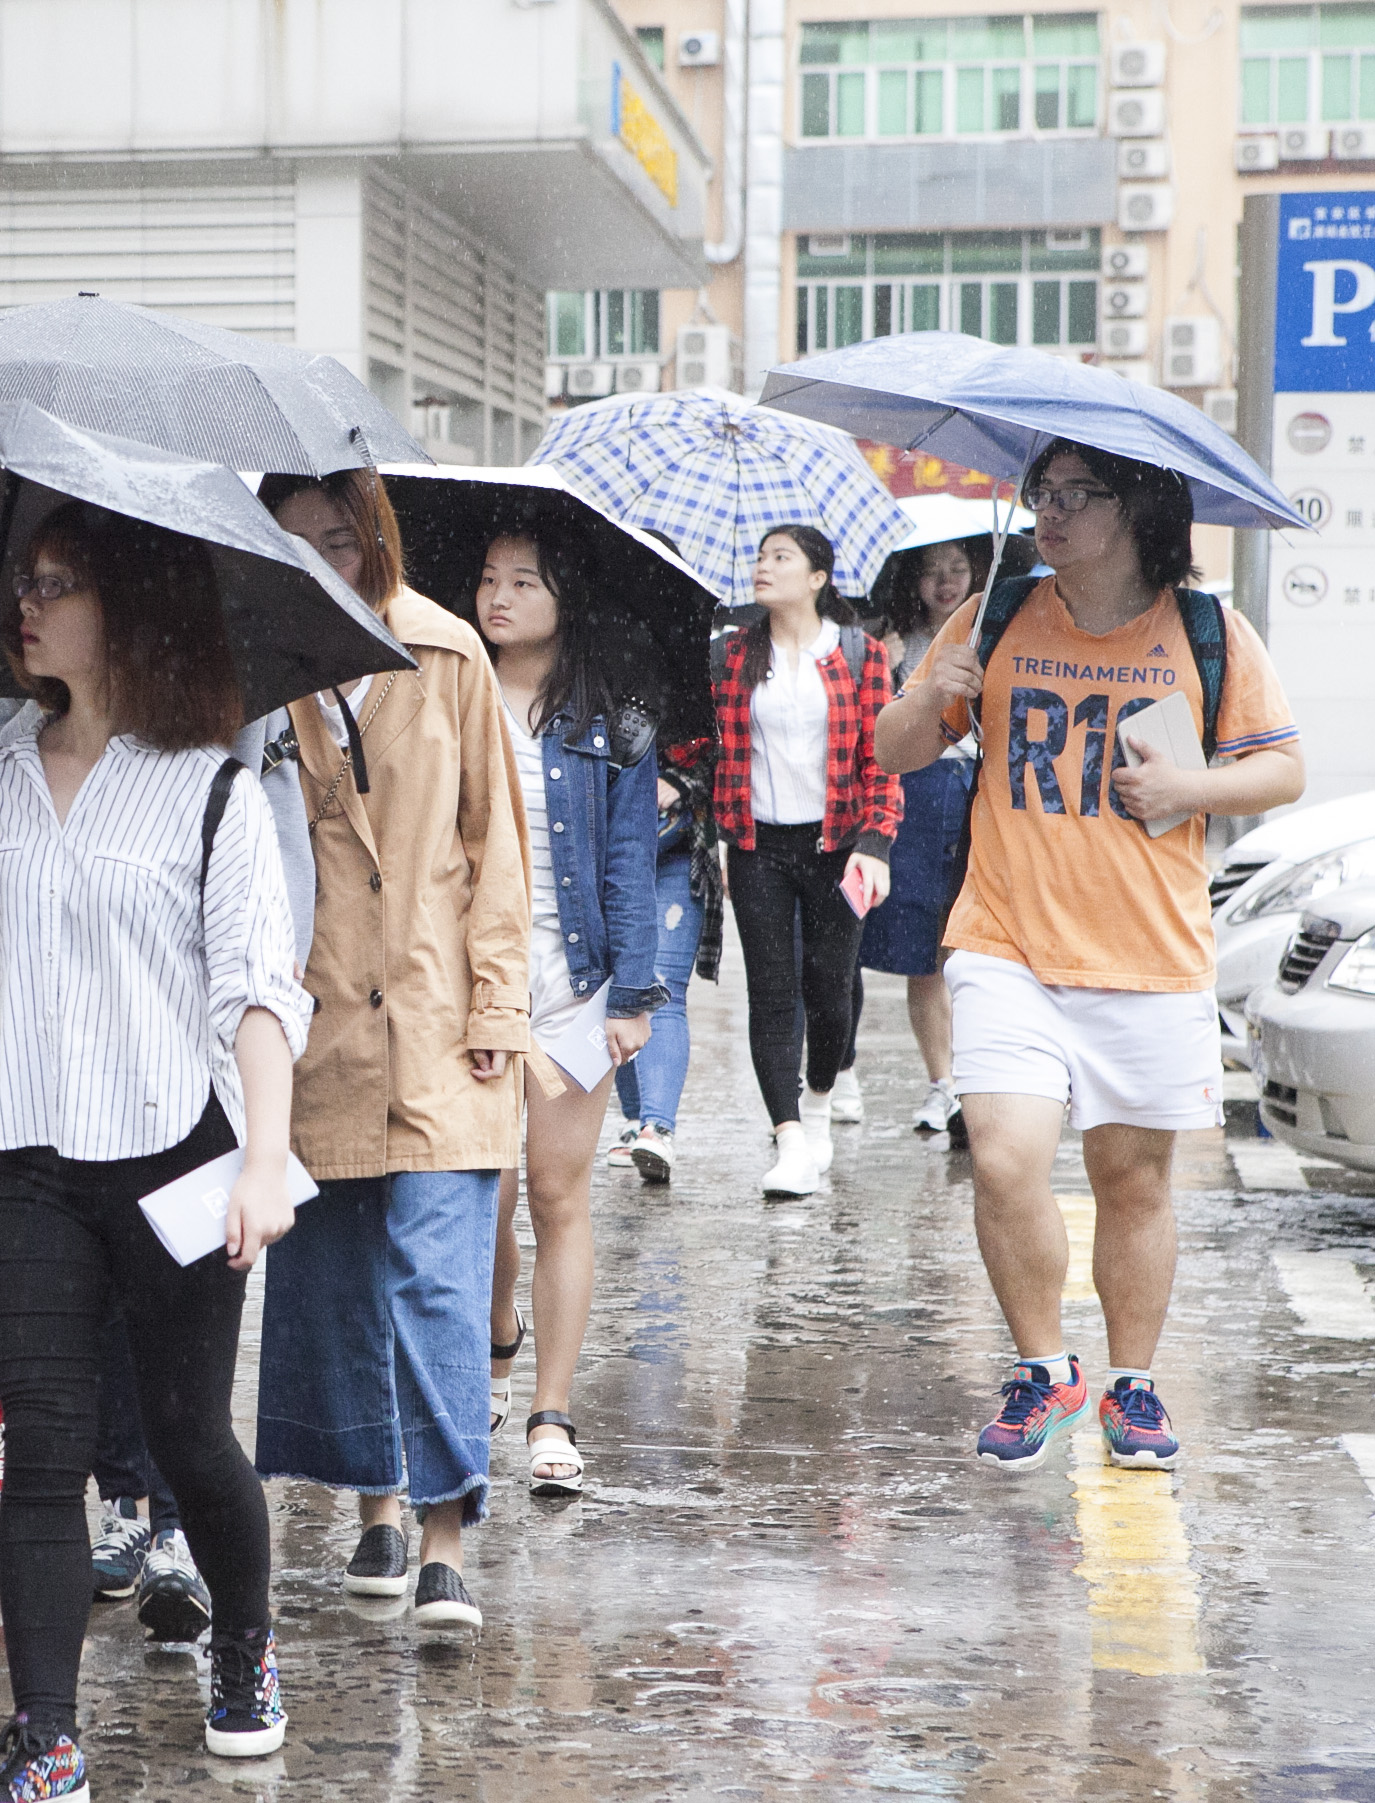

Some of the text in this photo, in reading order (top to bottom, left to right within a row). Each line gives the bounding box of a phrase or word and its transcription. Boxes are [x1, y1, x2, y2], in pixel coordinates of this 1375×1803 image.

[1301, 260, 1375, 346] P
[1296, 499, 1322, 523] 10
[1012, 656, 1175, 686] TREINAMENTO
